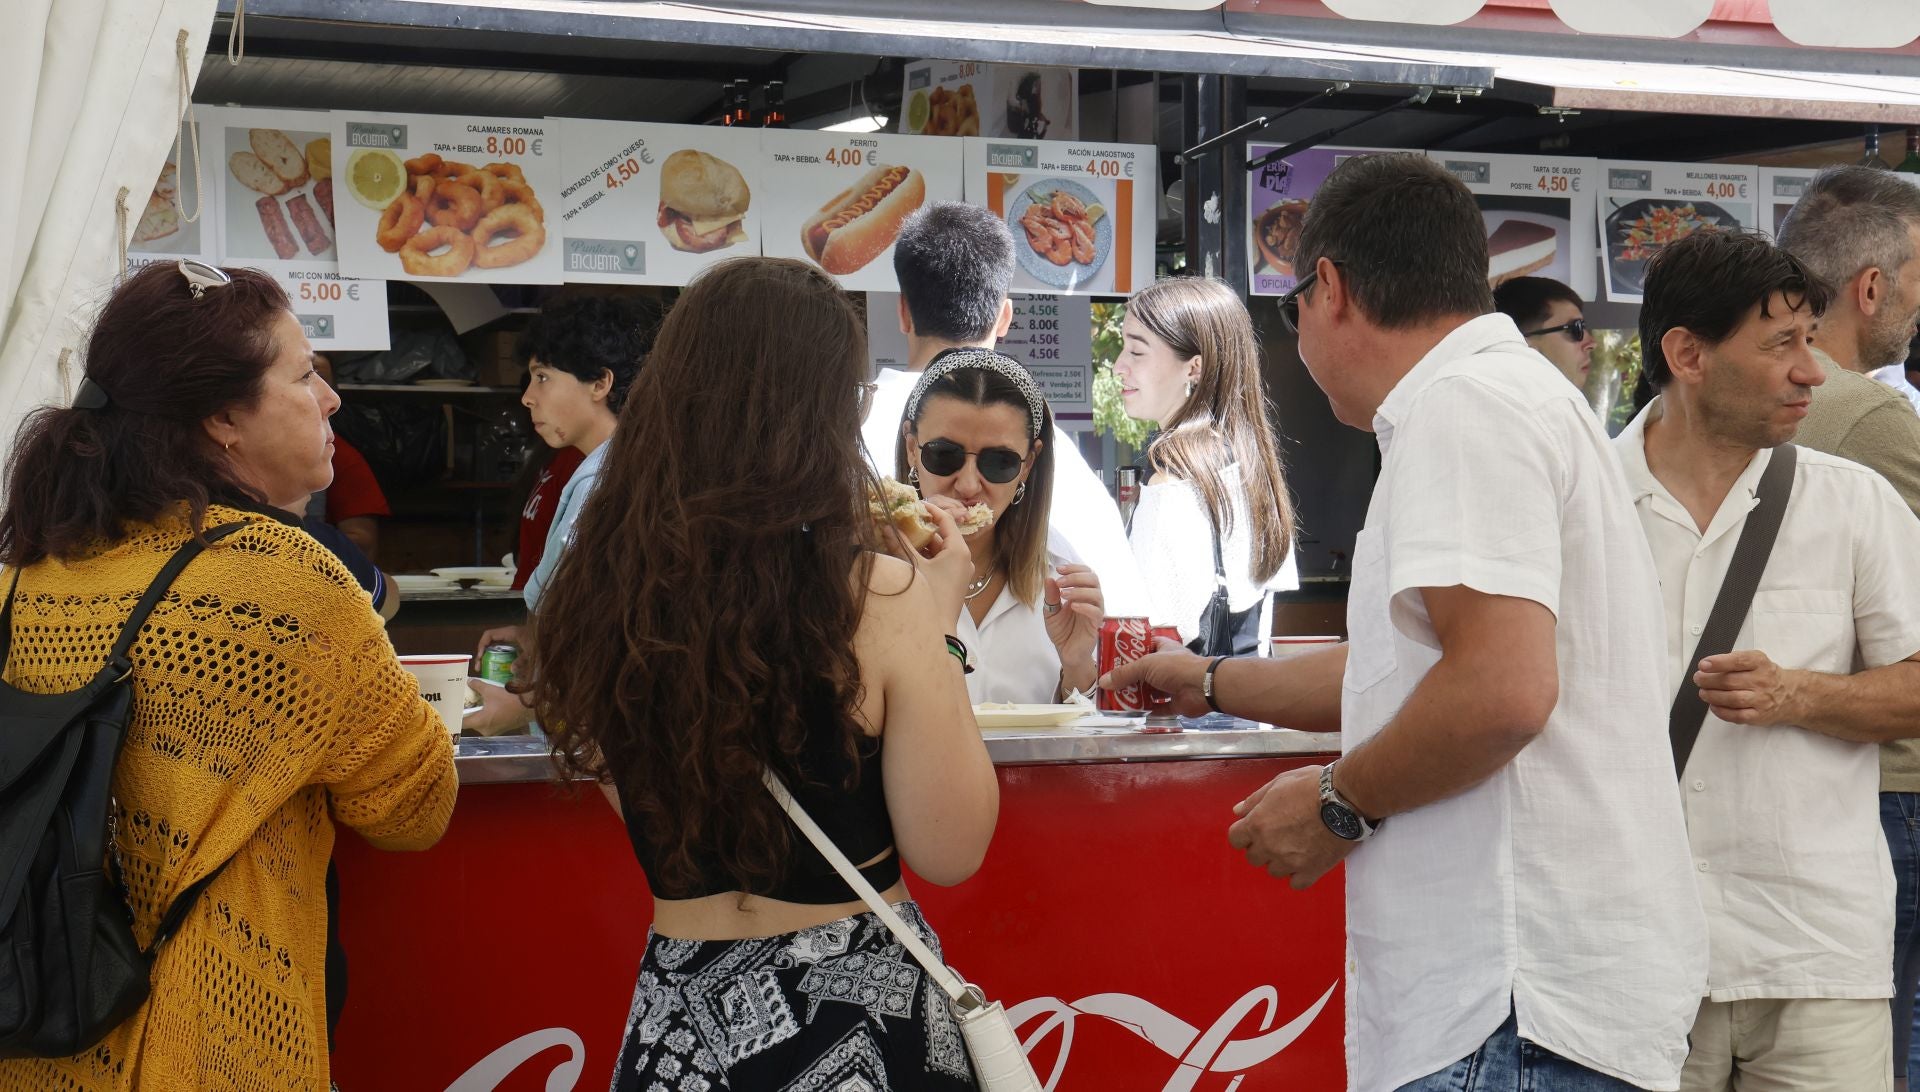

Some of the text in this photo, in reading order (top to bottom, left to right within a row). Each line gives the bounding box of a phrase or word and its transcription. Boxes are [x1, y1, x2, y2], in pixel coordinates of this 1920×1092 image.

[466, 124, 544, 136] CALAMARES ROMANA
[434, 143, 450, 152] TAPA
[486, 136, 526, 158] 8,00
[530, 138, 544, 156] €
[850, 138, 878, 148] PERRITO
[774, 154, 790, 162] TAPA
[826, 148, 862, 168] 4,00
[866, 150, 877, 166] €
[1068, 148, 1135, 160] RACIÓN LANGOSTINOS
[560, 138, 645, 199] MONTADO DE LOMO Y QUESO
[1041, 162, 1056, 170] TAPA
[1086, 160, 1120, 178] 4,00
[1124, 161, 1134, 177] €
[1264, 162, 1286, 172] ERIA
[1533, 166, 1550, 174] TARTA
[1552, 166, 1560, 174] DE
[1686, 172, 1748, 182] MEJILLONES VINAGRETA
[562, 209, 579, 222] TAPA
[606, 158, 640, 191] 4,50
[640, 148, 655, 165] €
[1537, 176, 1568, 193] 4,50
[1571, 177, 1581, 192] €
[1664, 188, 1677, 196] TAPA
[1706, 182, 1735, 200] 4,00
[1738, 184, 1747, 198] €
[288, 272, 304, 280] MICI
[306, 272, 322, 280] CON
[1262, 279, 1292, 290] OFICIAL
[300, 282, 360, 304] 5,00 €
[1028, 305, 1059, 316] 4.50€
[1029, 319, 1060, 330] 8.00€
[1029, 334, 1060, 345] 4.50€
[1029, 348, 1060, 360] 4.50€
